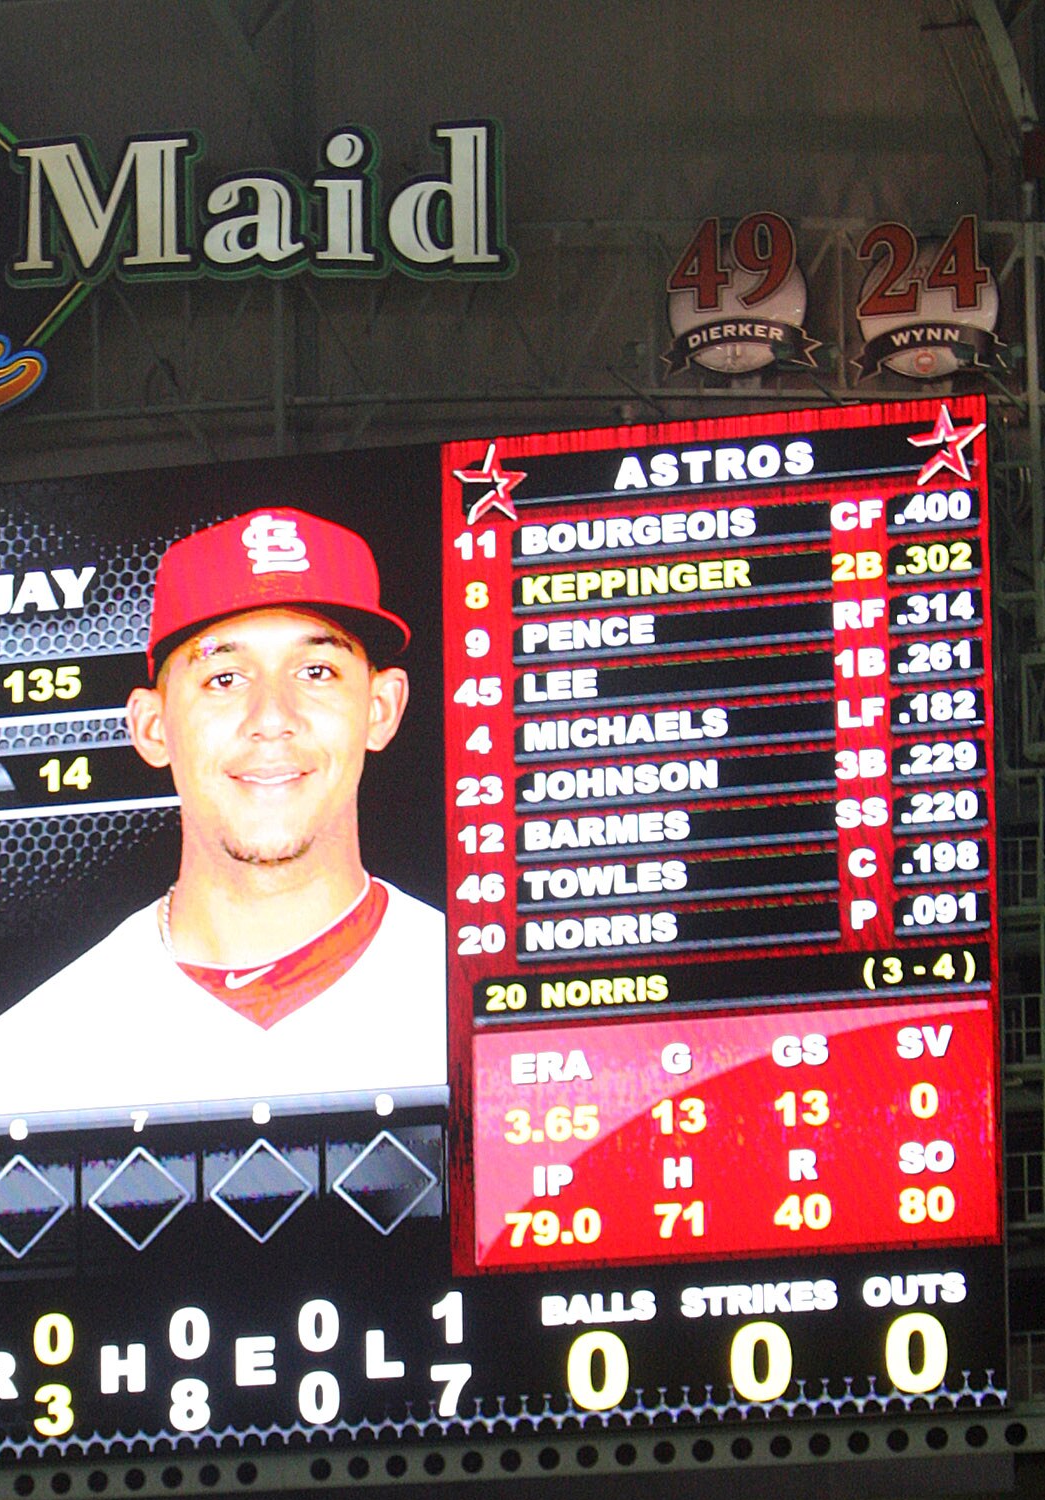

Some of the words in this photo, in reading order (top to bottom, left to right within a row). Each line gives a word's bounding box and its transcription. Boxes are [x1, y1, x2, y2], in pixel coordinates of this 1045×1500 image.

[12, 125, 499, 273] Maid
[667, 211, 796, 313] 49
[856, 214, 991, 319] 24
[687, 322, 784, 349] DIERKER
[891, 327, 960, 348] WYNN
[613, 441, 814, 491] ASTROS
[454, 530, 496, 561] 11
[521, 507, 757, 556] BOURGEOIS
[830, 499, 883, 531] CF
[894, 491, 971, 525] .400
[521, 559, 752, 605] KEPPINGER
[831, 551, 884, 582] 2B
[895, 541, 972, 576] .302
[522, 614, 656, 654] PENCE
[832, 598, 886, 631] RF
[896, 590, 975, 625] .314
[3, 665, 82, 704] 135
[453, 677, 503, 707] 45
[523, 668, 598, 703] LEE
[834, 647, 886, 678] 1B
[897, 639, 971, 674] .261
[523, 707, 729, 752] MICHAELS
[837, 697, 885, 729] LF
[898, 690, 977, 724] .182
[39, 756, 92, 793] 14
[455, 775, 504, 807] 23
[522, 759, 719, 803] JOHNSON
[834, 748, 887, 780] 3B
[899, 741, 977, 776] .229
[457, 823, 505, 854] 12
[524, 810, 691, 851] BARMES
[834, 796, 889, 829] SS
[900, 790, 978, 824] .220
[455, 873, 506, 904] 46
[523, 860, 688, 901] TOWLES
[901, 840, 980, 875] .198
[457, 923, 506, 956] 20
[525, 912, 678, 952] NORRIS
[902, 892, 977, 926] .091
[485, 983, 527, 1011] 20
[541, 974, 669, 1009] NORRIS
[510, 1050, 593, 1085] ERA
[771, 1032, 829, 1067] GS
[896, 1024, 953, 1059] SV
[503, 1101, 601, 1146] 3.65
[651, 1097, 707, 1135] 13
[774, 1089, 830, 1127] 13
[532, 1163, 574, 1197] IP
[898, 1140, 955, 1174] SO
[504, 1207, 602, 1248] 79.0
[653, 1200, 704, 1239] 71
[773, 1193, 832, 1231] 40
[898, 1185, 955, 1224] 80
[33, 1313, 74, 1365] 0
[168, 1306, 210, 1360] 0
[297, 1299, 340, 1353] 0
[432, 1291, 463, 1344] 1
[541, 1290, 657, 1326] BALLS
[680, 1279, 838, 1318] STRIKES
[862, 1271, 967, 1308] OUTS
[100, 1343, 146, 1394] H
[235, 1335, 277, 1387] E
[365, 1329, 405, 1379] L
[567, 1330, 629, 1411] 0
[730, 1321, 793, 1402] 0
[885, 1312, 948, 1395] 0
[33, 1383, 74, 1437] 3
[169, 1378, 211, 1432] 8
[298, 1370, 340, 1425] 0
[430, 1363, 472, 1417] 7
